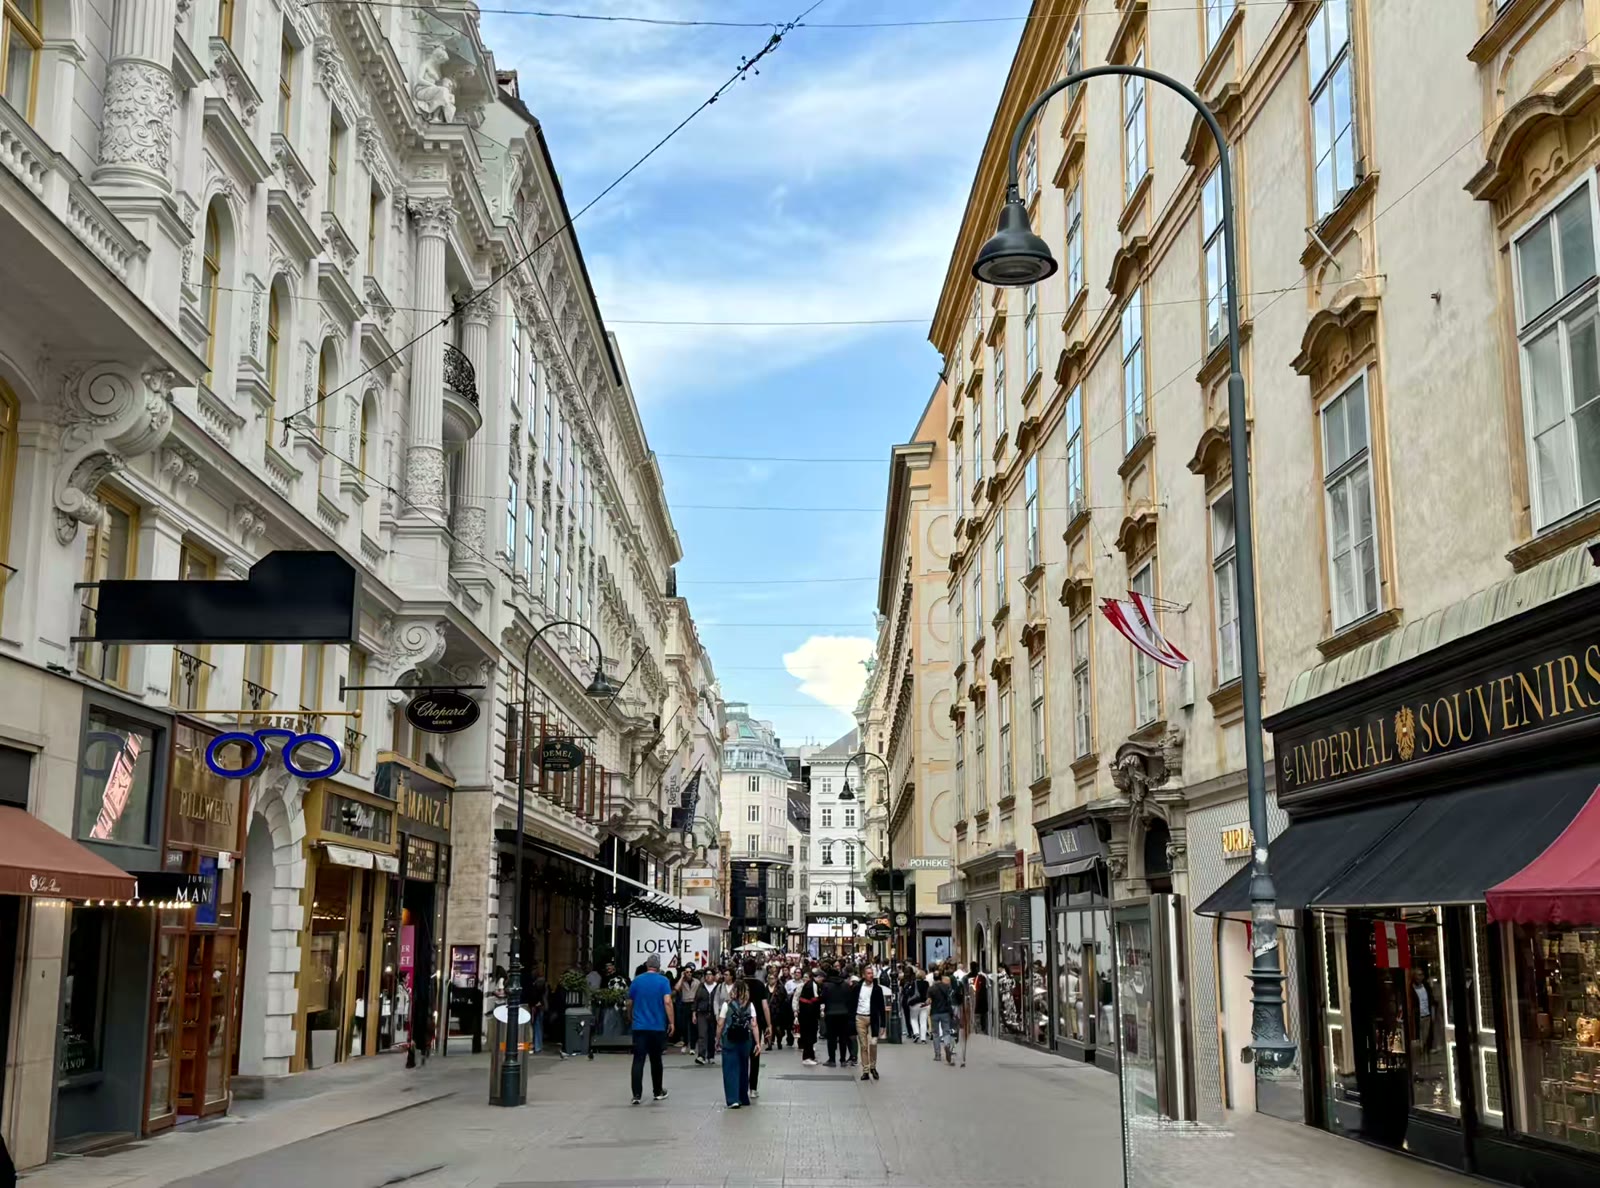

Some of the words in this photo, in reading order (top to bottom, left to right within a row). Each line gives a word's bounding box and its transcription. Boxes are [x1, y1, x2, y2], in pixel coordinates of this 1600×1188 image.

[413, 701, 473, 720] Chopard
[1293, 718, 1393, 786] IMPERIAL
[1419, 645, 1600, 753] SOUVENIRS
[543, 750, 573, 759] DEMEL
[668, 775, 680, 806] Regus
[178, 789, 233, 826] PILLWEIN
[407, 788, 440, 827] MANZ
[636, 939, 693, 953] LOEWE
